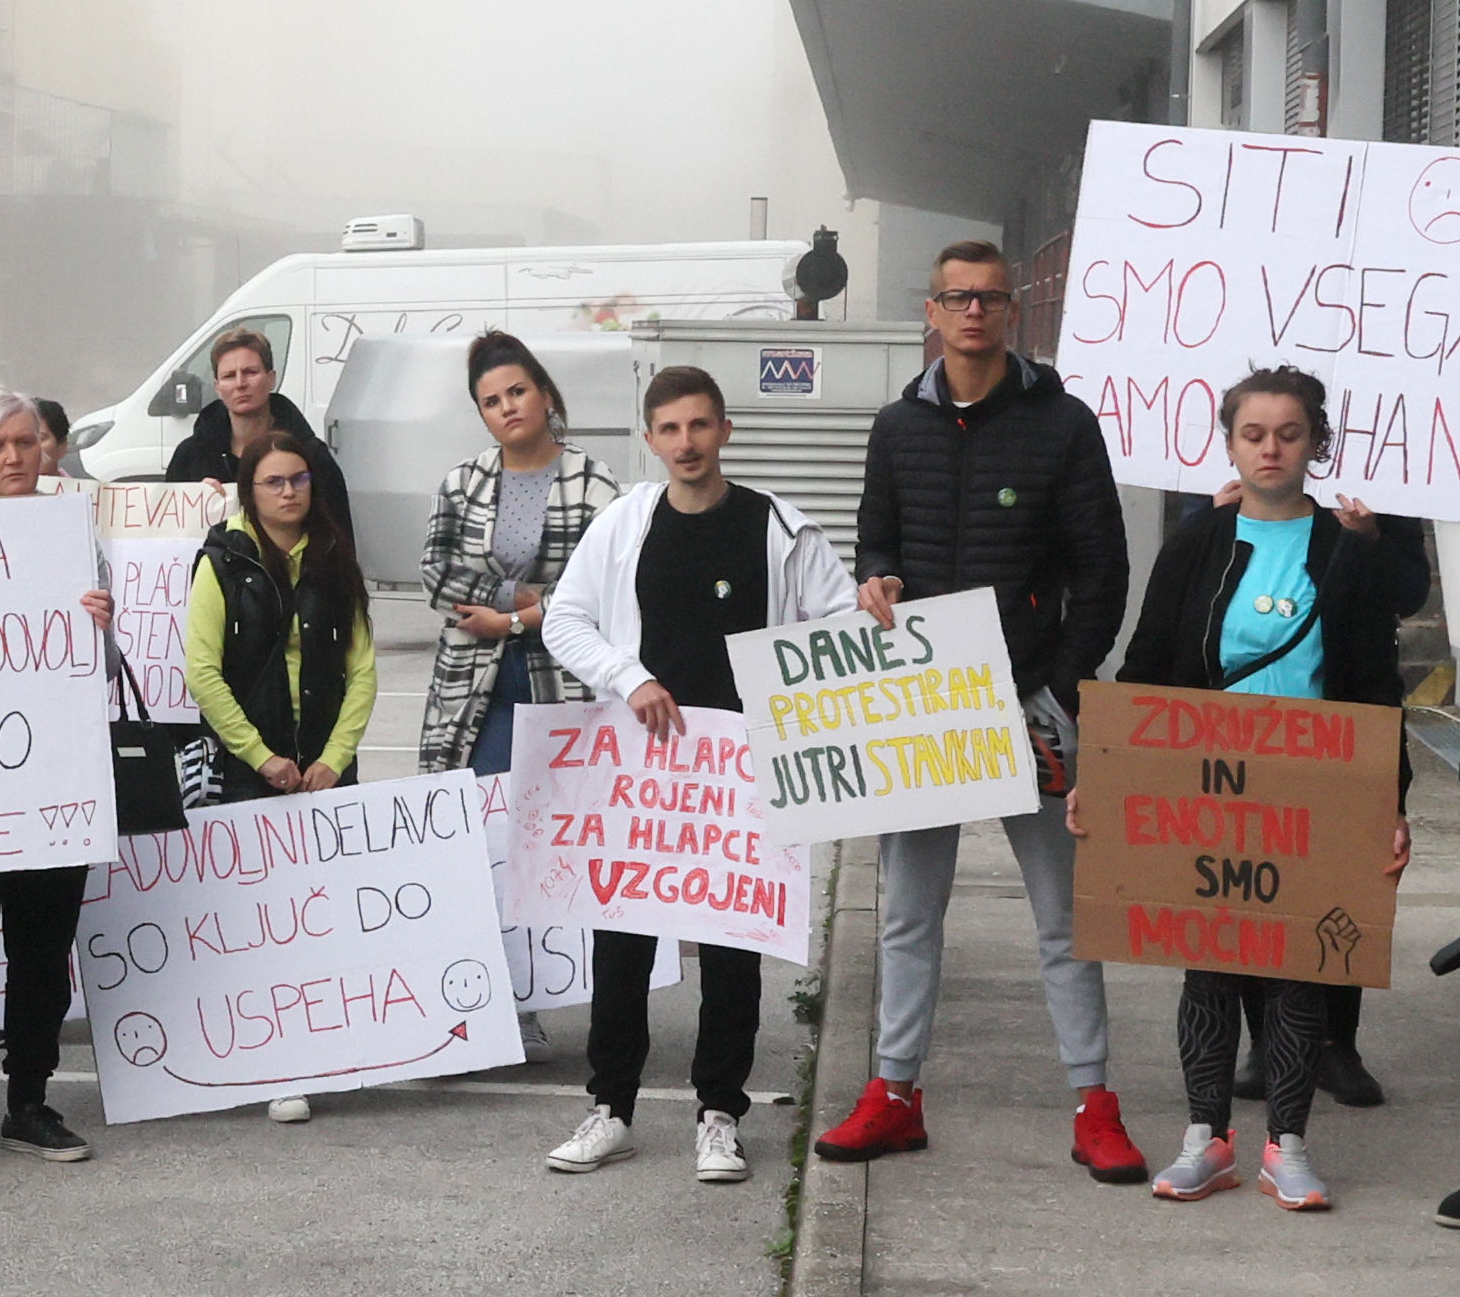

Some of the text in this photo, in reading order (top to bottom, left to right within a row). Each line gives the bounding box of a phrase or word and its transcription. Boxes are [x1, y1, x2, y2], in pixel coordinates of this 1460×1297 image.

[1128, 139, 1353, 238] SITI
[1073, 258, 1227, 348] SMO
[1061, 375, 1216, 467] AMO
[773, 614, 934, 687] DANES
[769, 663, 1006, 740] PROTESTIRAM,
[548, 725, 756, 784] ZA HLAPC
[770, 726, 1019, 809] JUTRI STAVKAM
[1201, 758, 1247, 796] IN
[608, 774, 736, 818] ROJENI
[1124, 795, 1312, 859] ENOTNI
[81, 809, 309, 904] ADOVOLJNI
[310, 787, 472, 863] DELAVCI
[550, 813, 605, 848] ZA
[627, 815, 761, 866] HLAPCE
[588, 858, 787, 928] VZGOJENI
[1194, 854, 1280, 905] SMO
[88, 922, 169, 992] SO
[182, 886, 334, 963] KLJUČ
[357, 882, 432, 933] DO
[1126, 903, 1286, 972] MOČNI
[200, 967, 427, 1060] USPEHA
